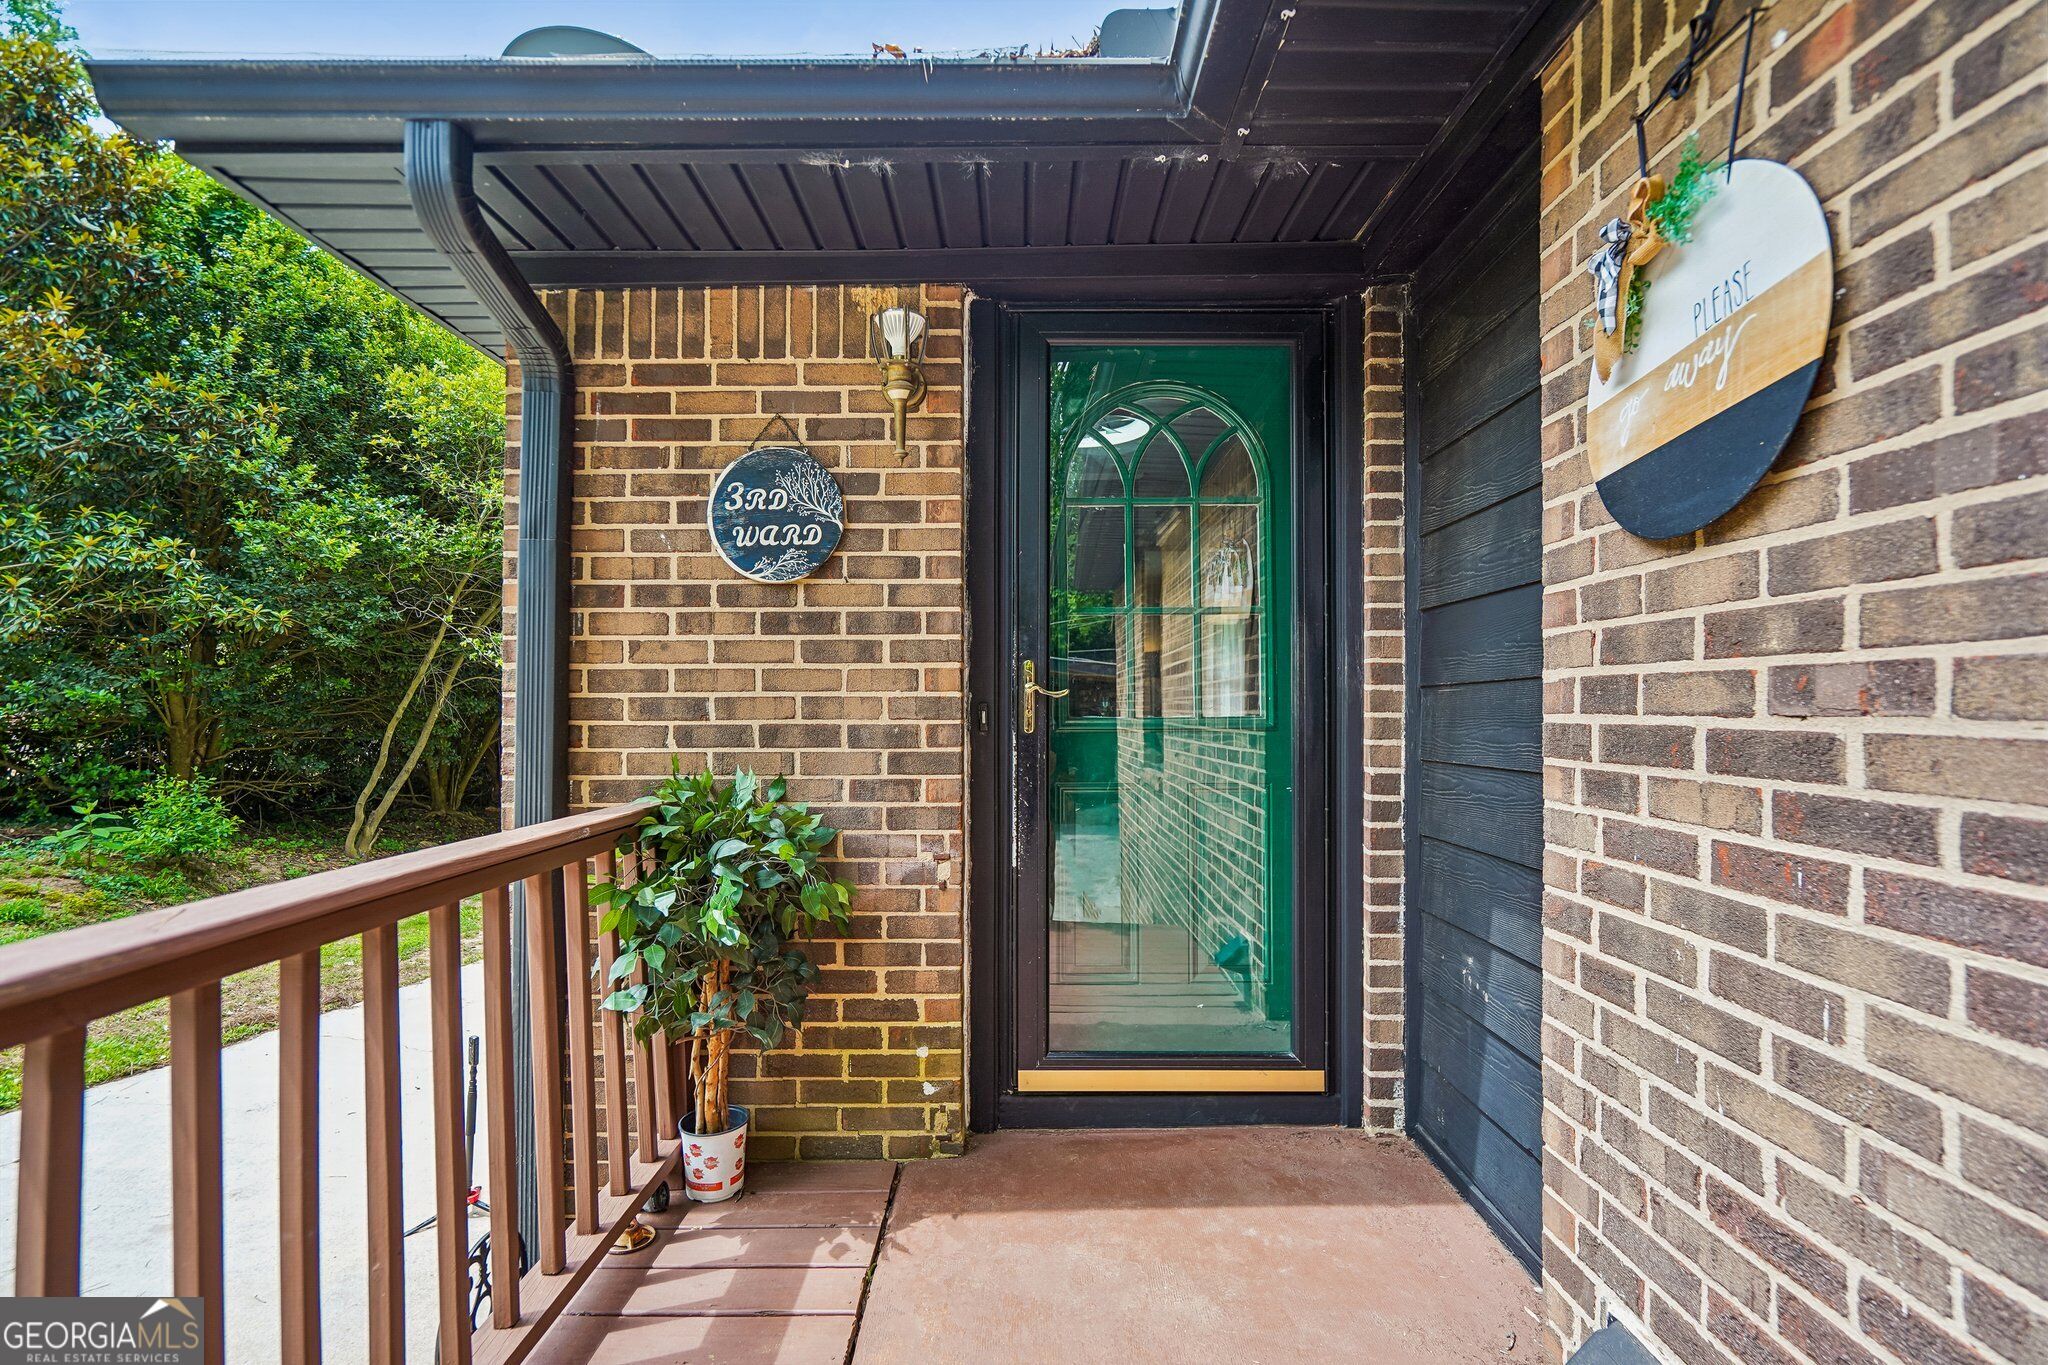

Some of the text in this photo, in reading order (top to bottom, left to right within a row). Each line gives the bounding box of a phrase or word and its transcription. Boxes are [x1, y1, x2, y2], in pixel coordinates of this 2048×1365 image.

[1693, 259, 1754, 338] PLEASE
[1619, 313, 1757, 447] go away
[724, 482, 788, 511] 3RD
[732, 524, 823, 547] WARD
